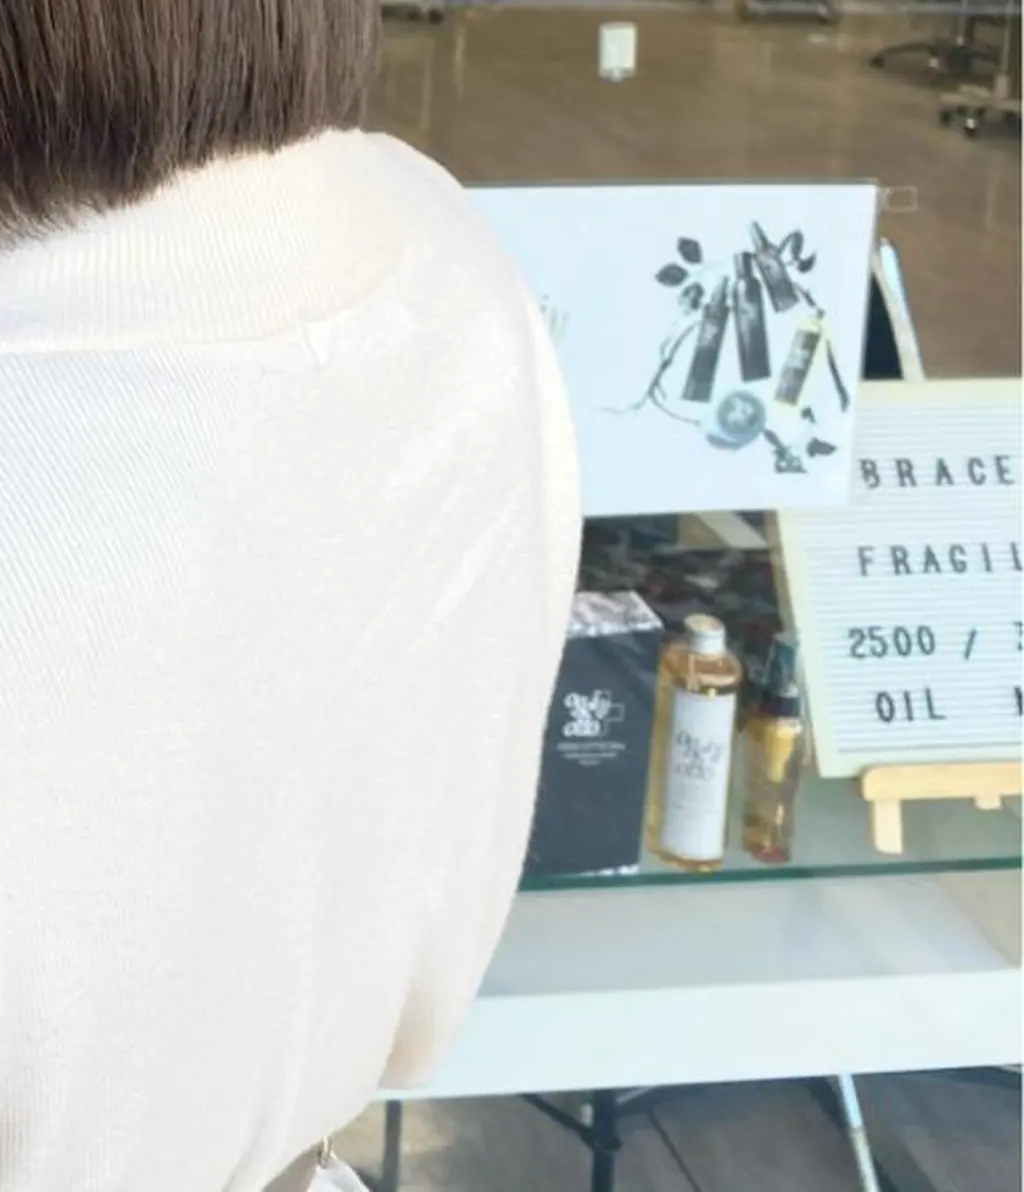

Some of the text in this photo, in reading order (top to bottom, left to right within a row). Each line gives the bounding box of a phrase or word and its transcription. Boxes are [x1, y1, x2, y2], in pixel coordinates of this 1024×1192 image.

[860, 455, 1015, 489] BRACE
[848, 625, 936, 659] 2500
[875, 687, 947, 723] OIL
